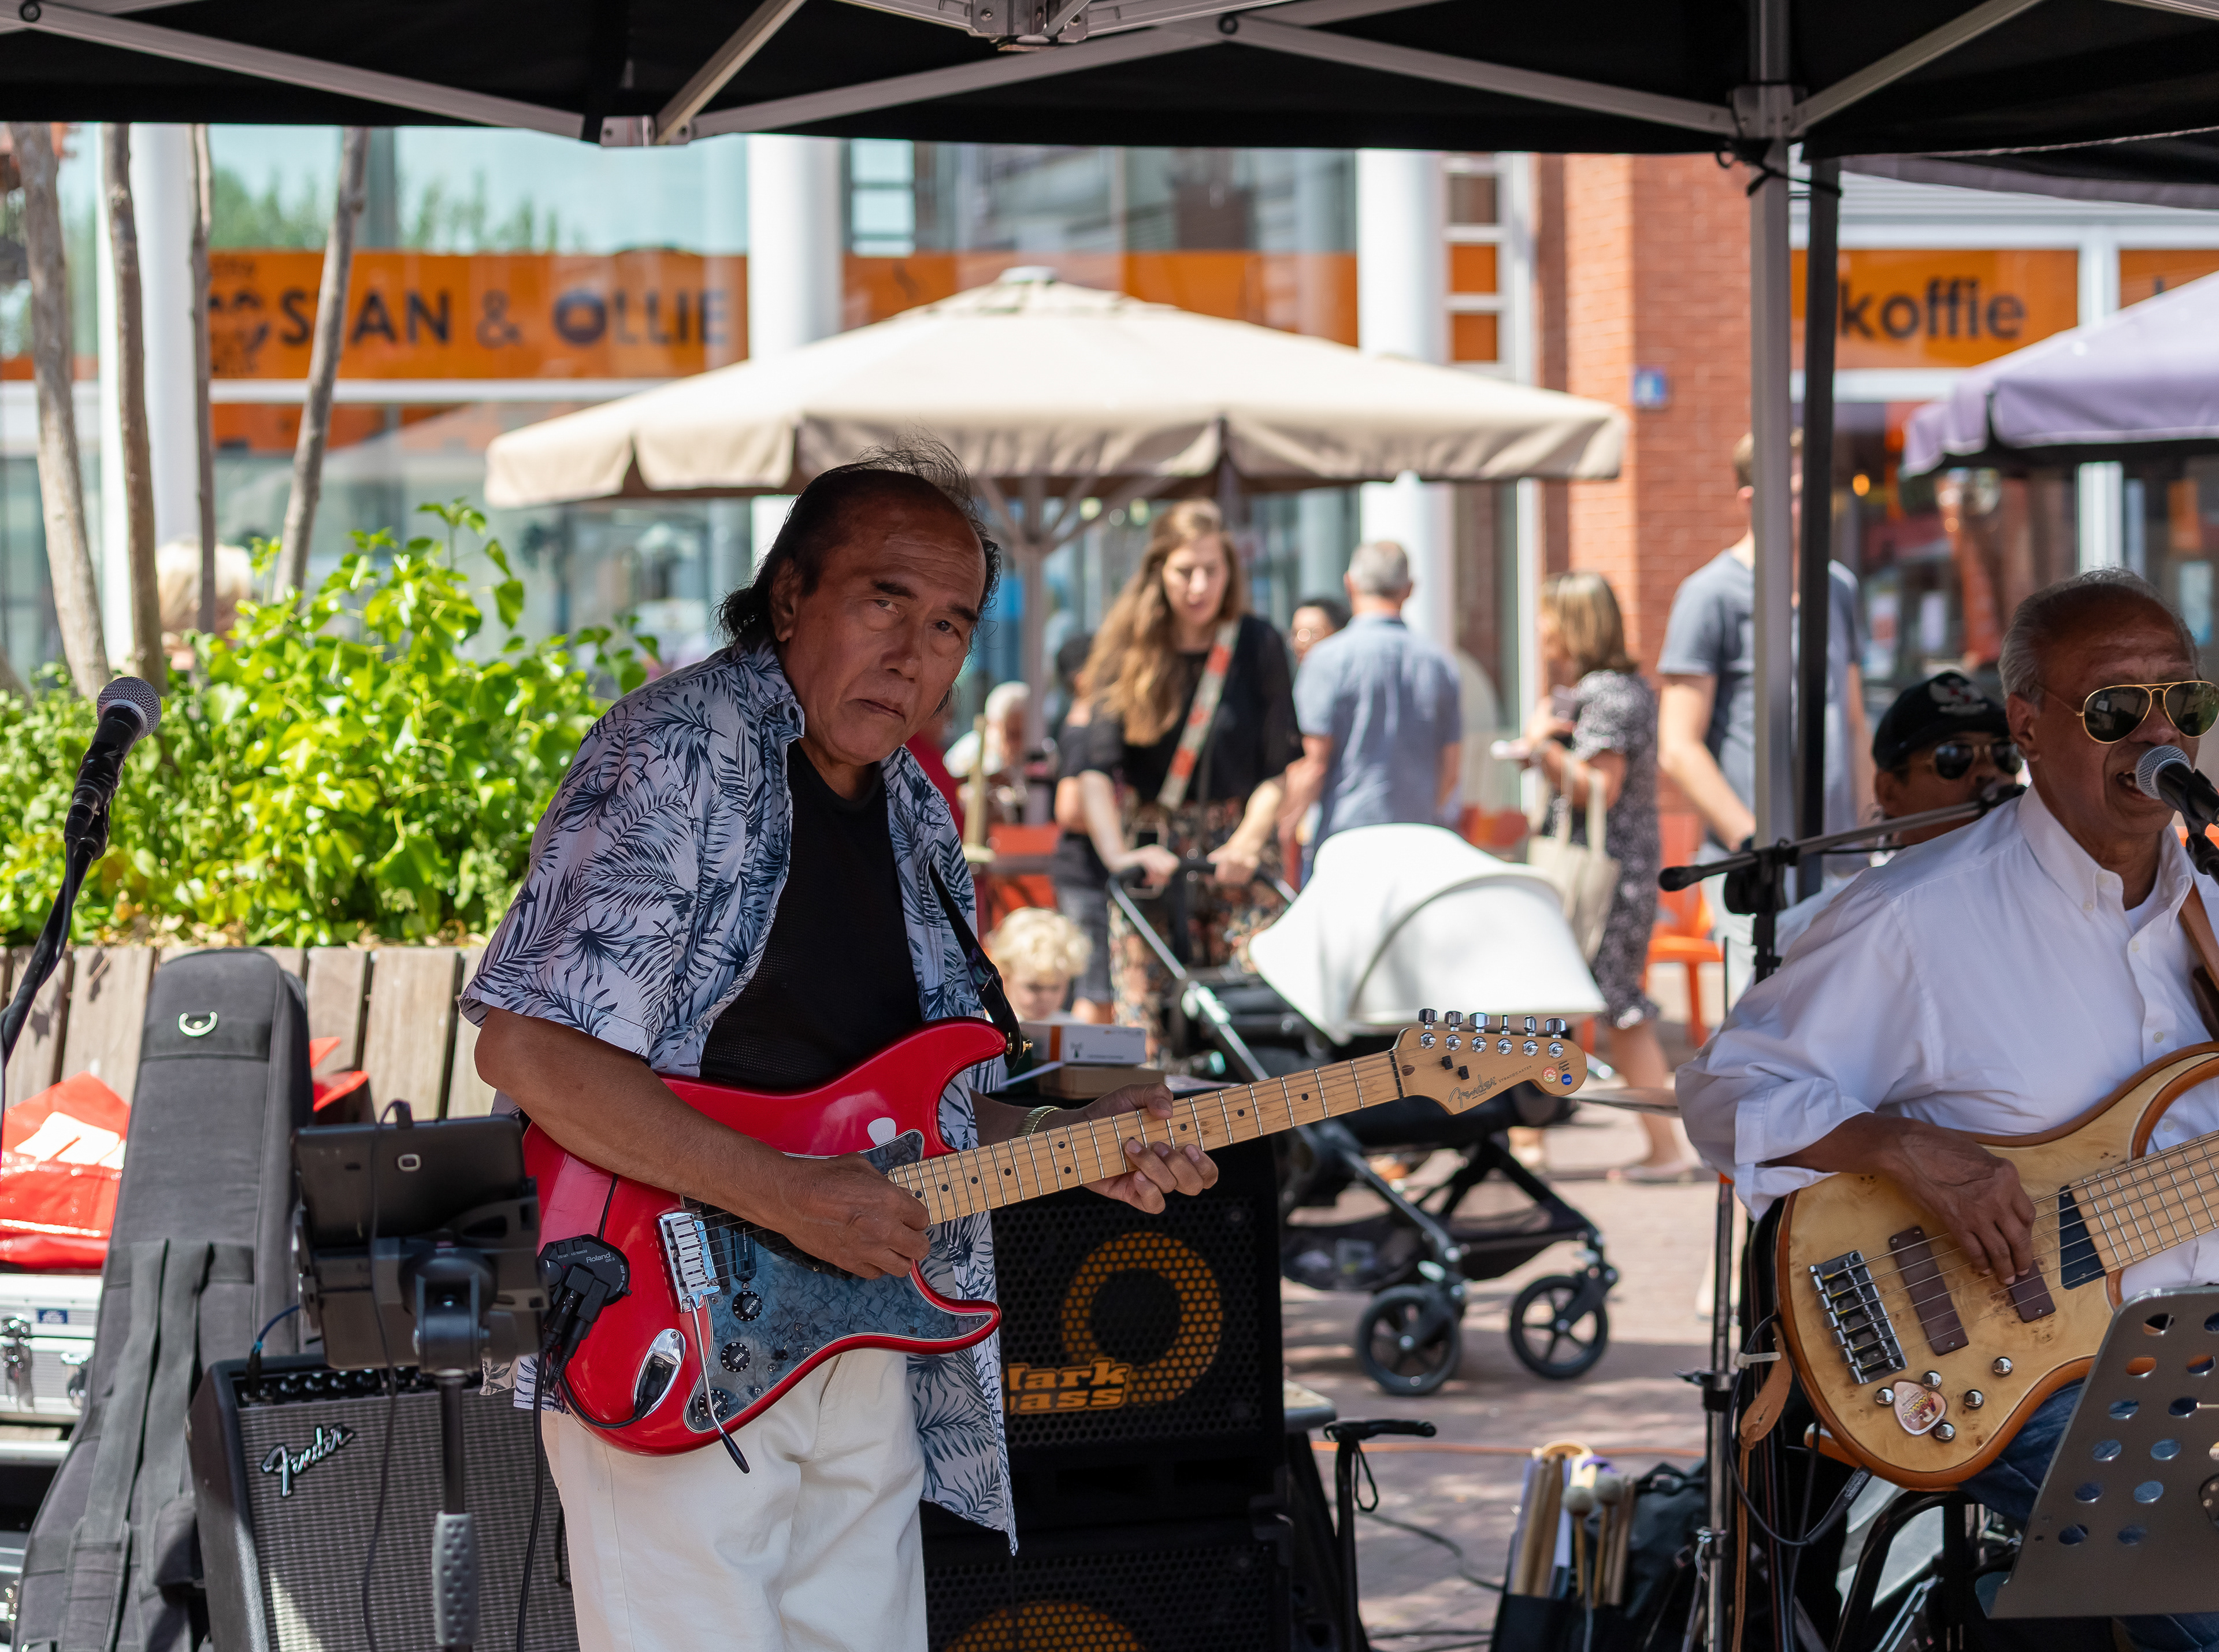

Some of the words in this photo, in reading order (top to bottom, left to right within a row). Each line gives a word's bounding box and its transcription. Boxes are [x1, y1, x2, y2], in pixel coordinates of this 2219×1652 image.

[279, 287, 450, 347] SAN
[476, 289, 522, 348] &
[552, 288, 726, 348] OLLIE
[1840, 277, 2026, 340] koffie
[1448, 1074, 1497, 1108] Fender
[586, 1252, 611, 1263] Roland
[745, 1300, 758, 1314] VOLUME
[733, 1352, 744, 1364] TONE
[262, 1427, 355, 1497] Fender
